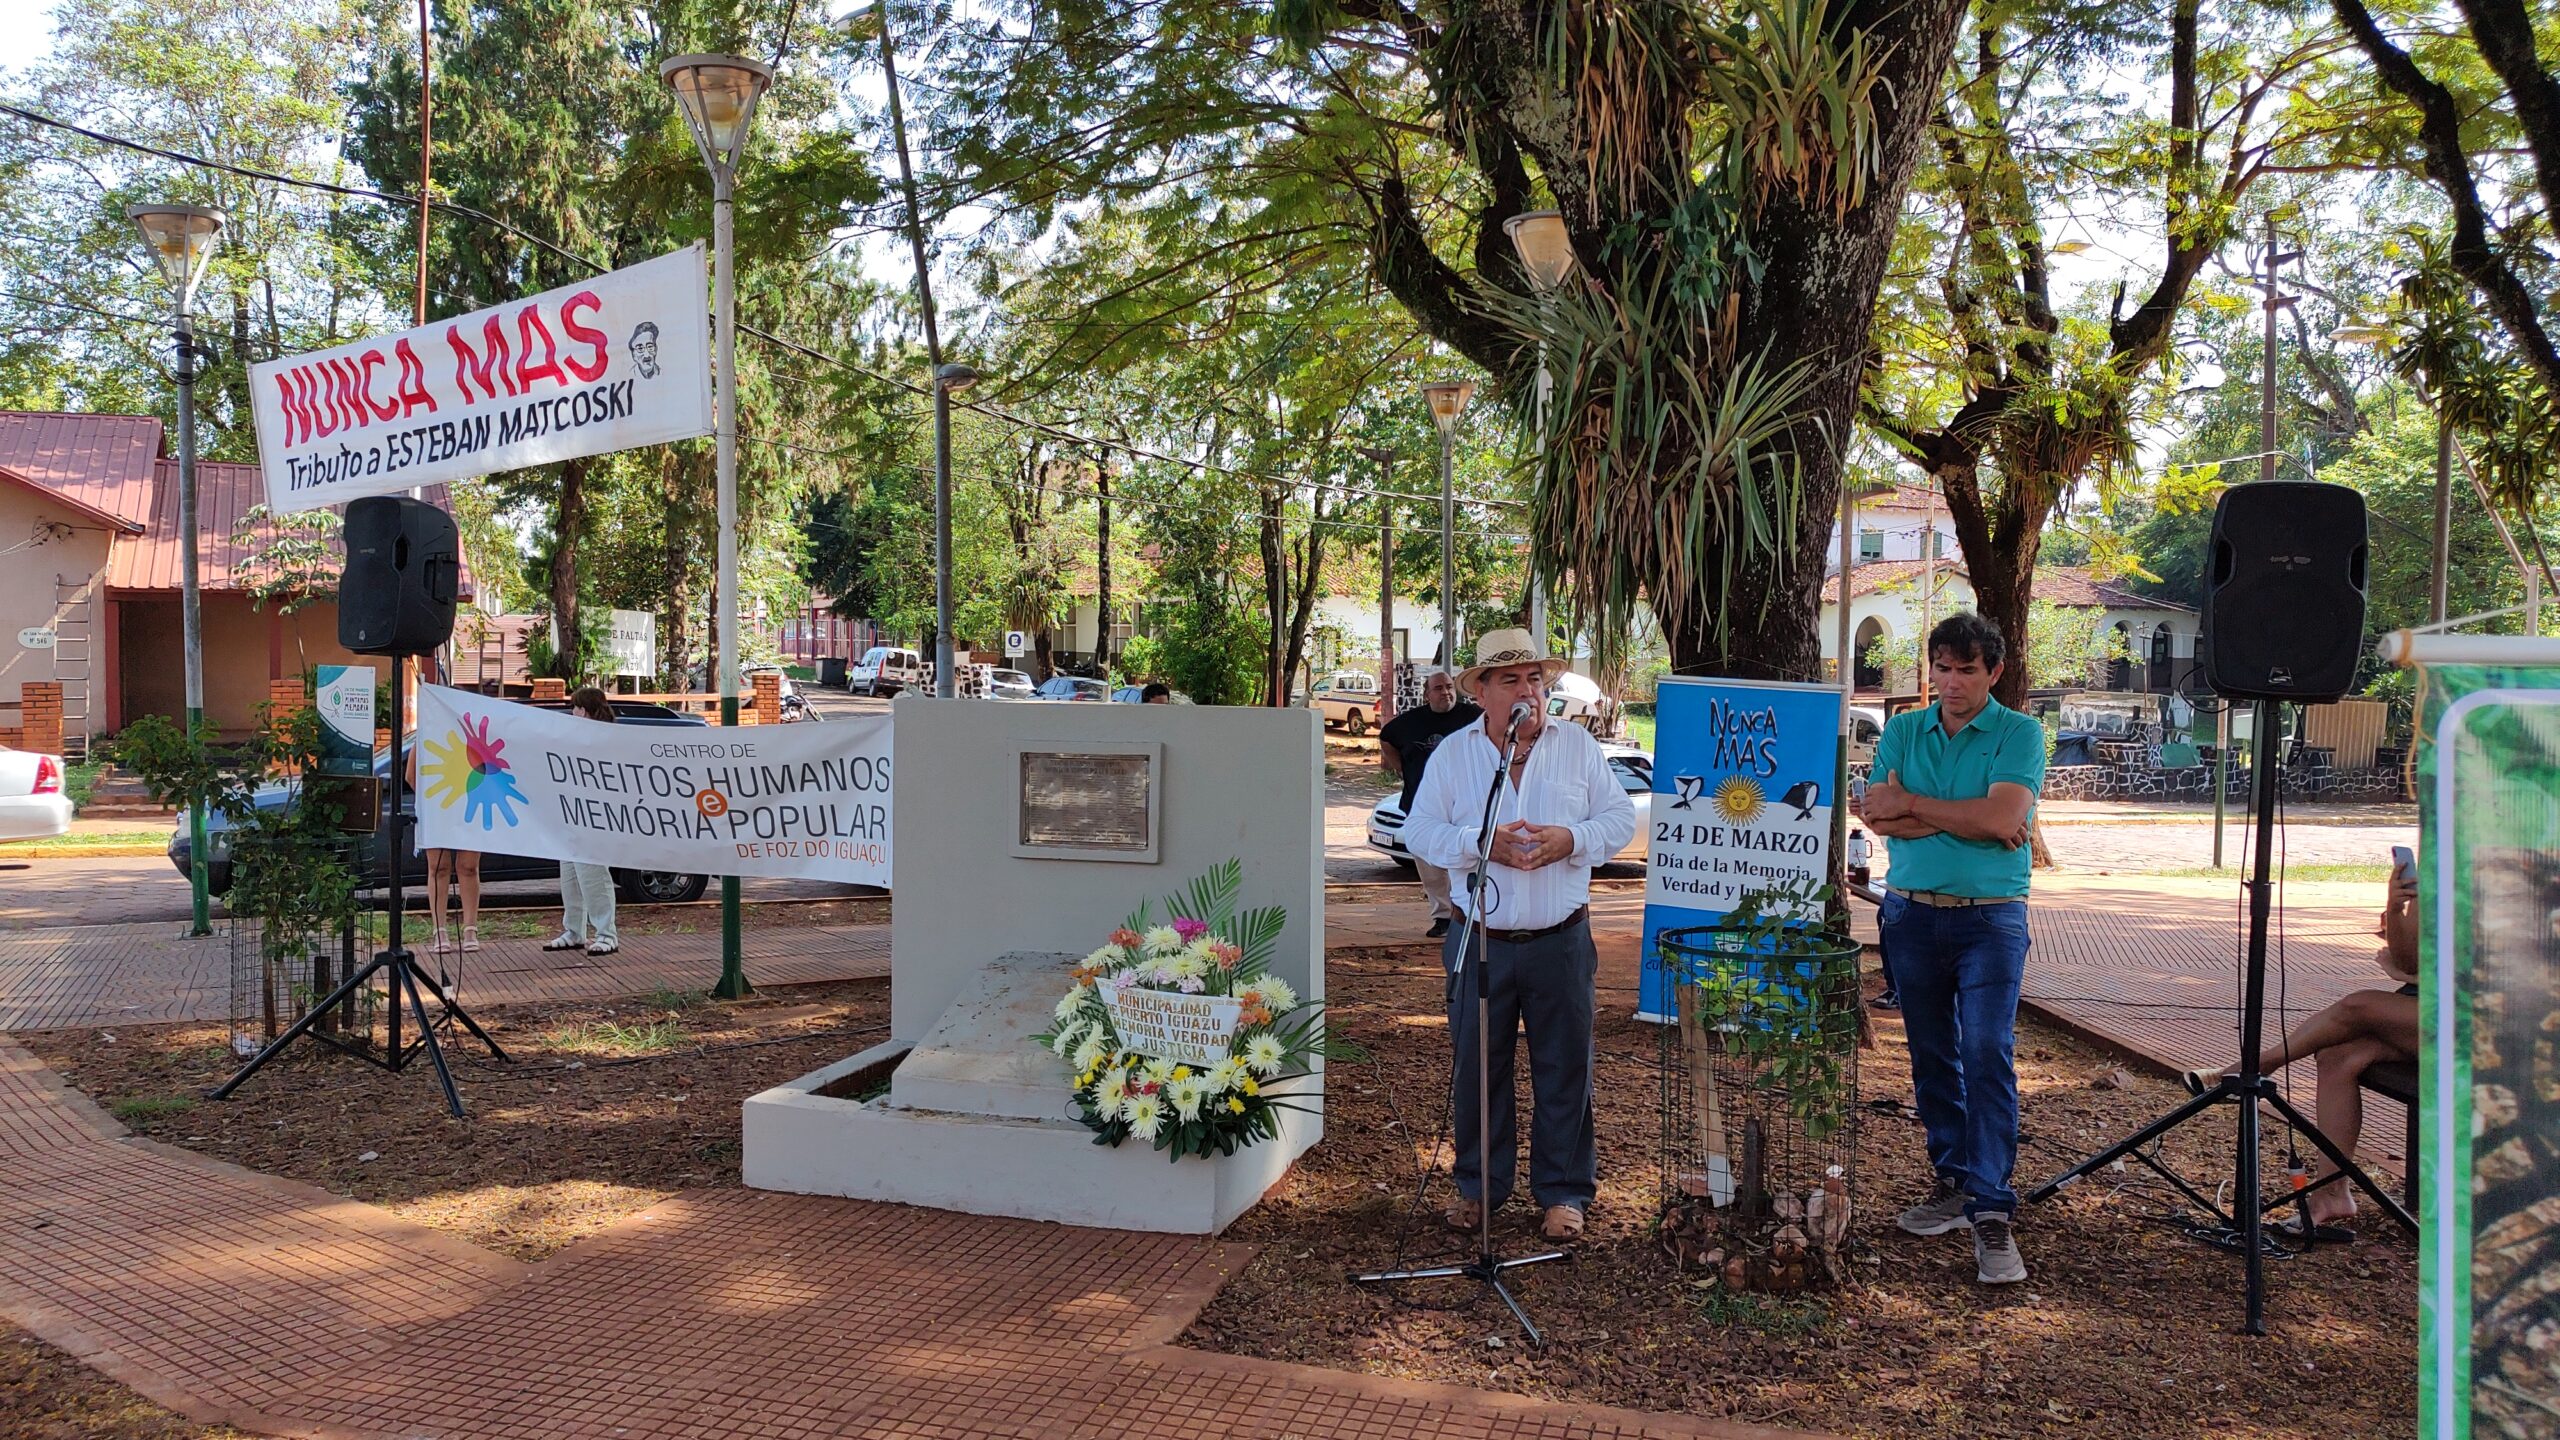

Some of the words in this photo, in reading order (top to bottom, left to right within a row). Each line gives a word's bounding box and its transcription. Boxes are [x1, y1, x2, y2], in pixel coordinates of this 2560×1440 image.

[275, 337, 437, 449] NUNCA
[447, 290, 609, 405] MAS
[286, 442, 361, 491] Tributo
[367, 448, 381, 475] a
[386, 414, 492, 473] ESTEBAN
[498, 378, 635, 448] MATCOSKI
[650, 743, 725, 759] CENTRO
[732, 743, 757, 758] DE
[1713, 734, 1778, 779] MAS
[546, 751, 696, 799] DIREITOS
[707, 756, 891, 798] HUMANOS
[559, 794, 718, 840] MEMÓRIA
[728, 804, 886, 841] POPULAR
[1656, 822, 1685, 843] 24
[1691, 825, 1724, 846] DE
[1731, 828, 1819, 855] MARZO
[736, 843, 761, 858] DE
[766, 842, 800, 858] FOZ
[805, 841, 830, 858] DO
[835, 841, 886, 867] IGUAÇU
[1656, 852, 1683, 869] Día
[1688, 855, 1709, 871] de
[1713, 858, 1728, 873] la
[1733, 860, 1810, 880] Memoria
[1661, 876, 1720, 895] Verdad
[1724, 885, 1735, 901] y
[1117, 992, 1211, 1017] MUNICIPALIDAD
[1120, 1006, 1163, 1025] PUERTO
[1168, 1013, 1221, 1031] IGUAZU
[1113, 1016, 1166, 1040] MEMORIA
[1171, 1029, 1230, 1046] VERDAD
[1126, 1033, 1133, 1048] Y
[1141, 1037, 1207, 1059] JUSTICIA
